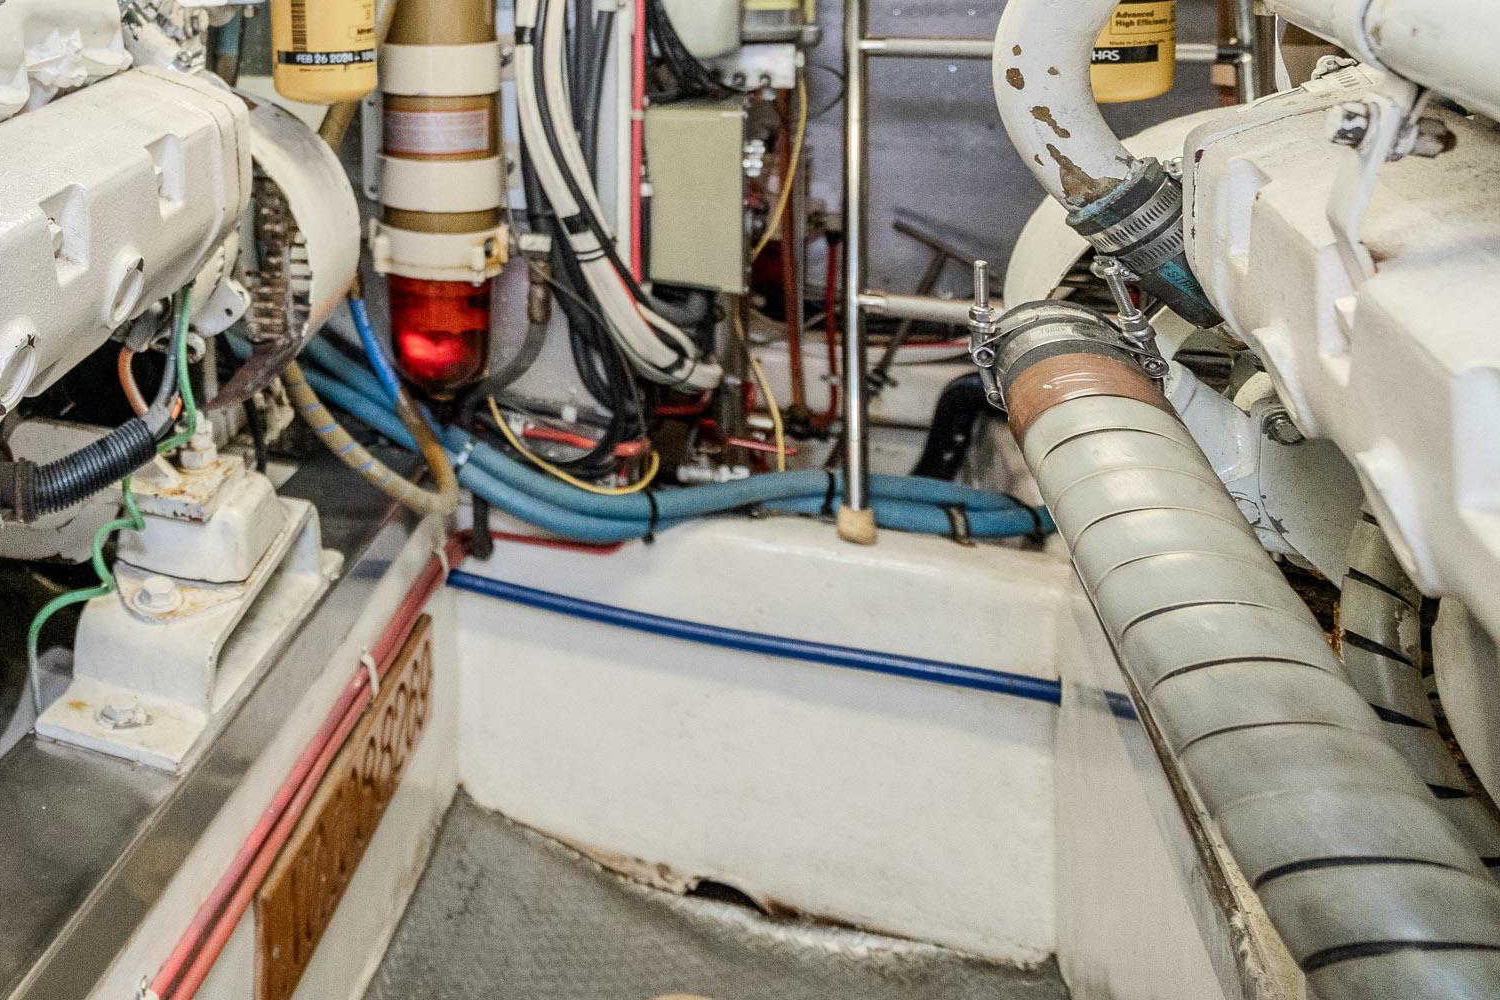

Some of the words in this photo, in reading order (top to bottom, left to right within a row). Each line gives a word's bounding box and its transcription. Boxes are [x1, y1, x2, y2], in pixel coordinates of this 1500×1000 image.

[1116, 10, 1154, 18] Advanced
[1116, 20, 1135, 28] High
[296, 53, 313, 63] FEB
[314, 53, 328, 63] 26
